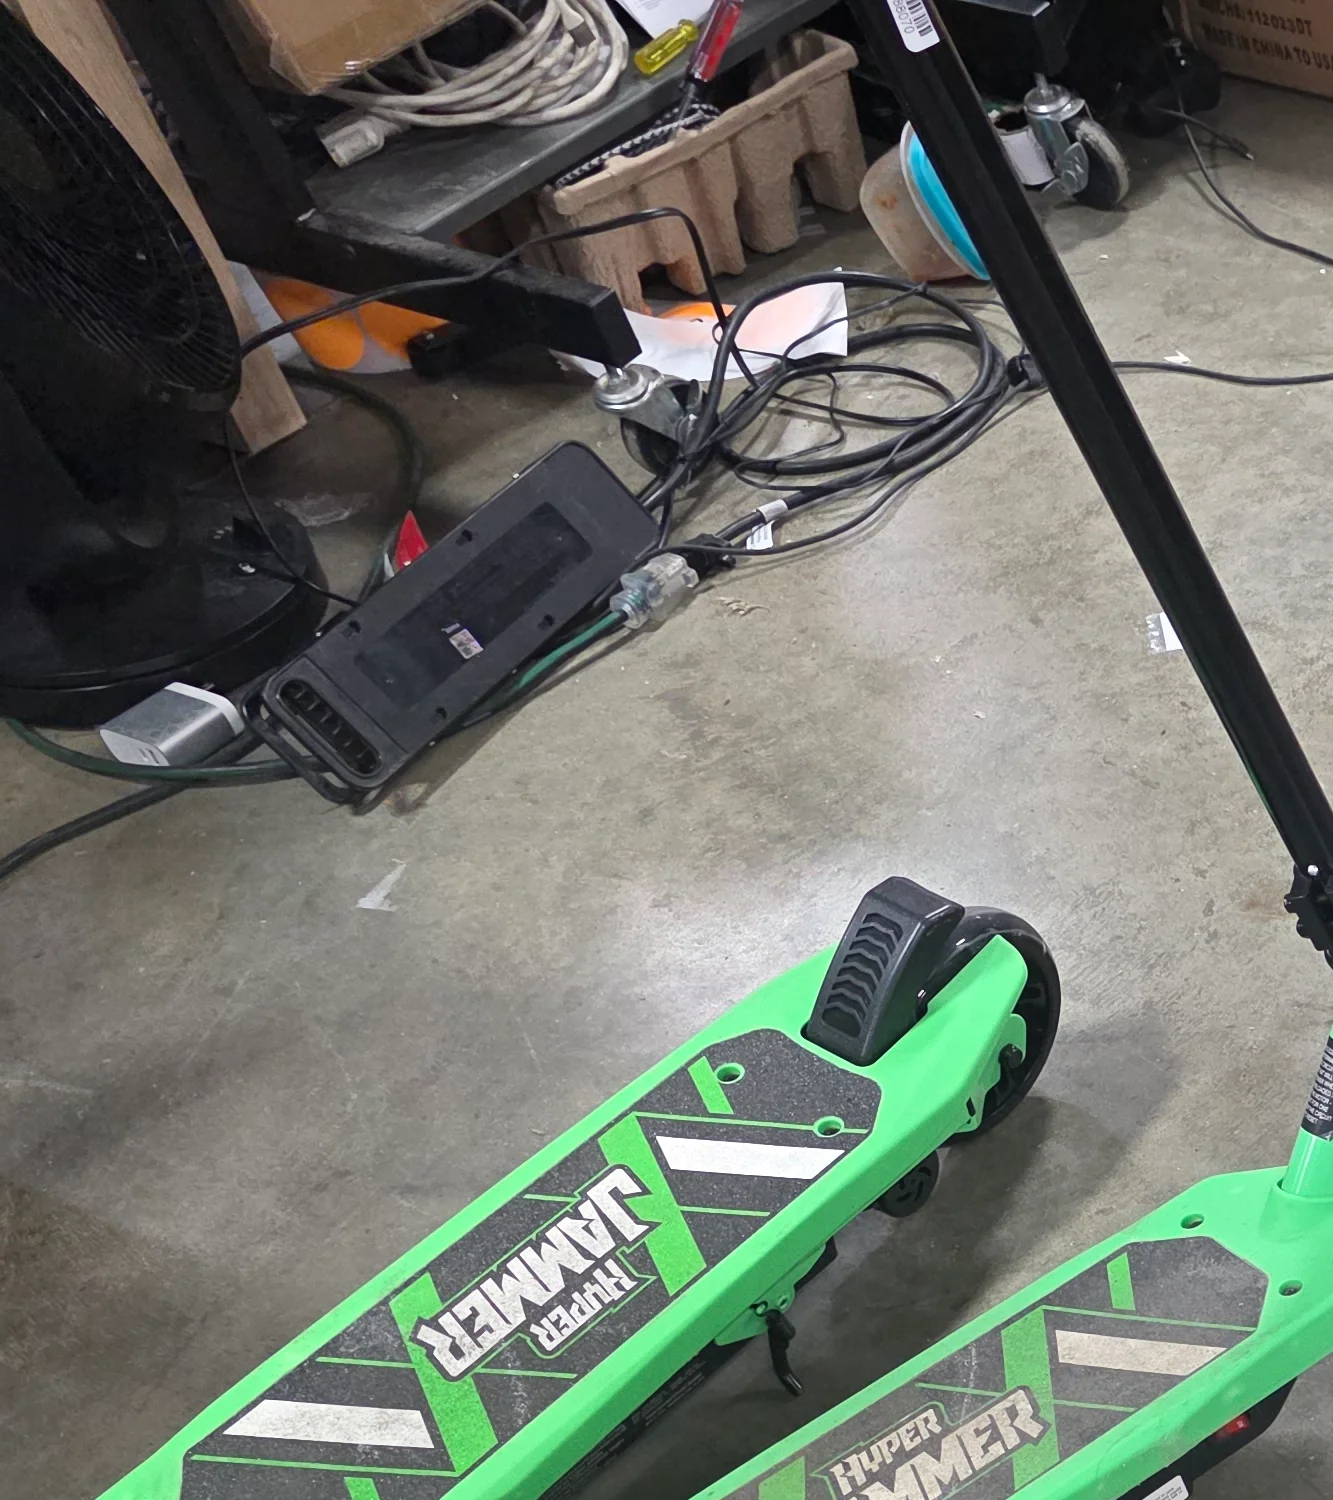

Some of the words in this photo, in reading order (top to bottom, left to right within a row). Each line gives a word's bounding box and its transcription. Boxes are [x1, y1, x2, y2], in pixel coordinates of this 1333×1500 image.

[416, 1168, 650, 1378] JAMMER
[529, 1258, 638, 1351] HYPER
[829, 1408, 942, 1496] HYPER
